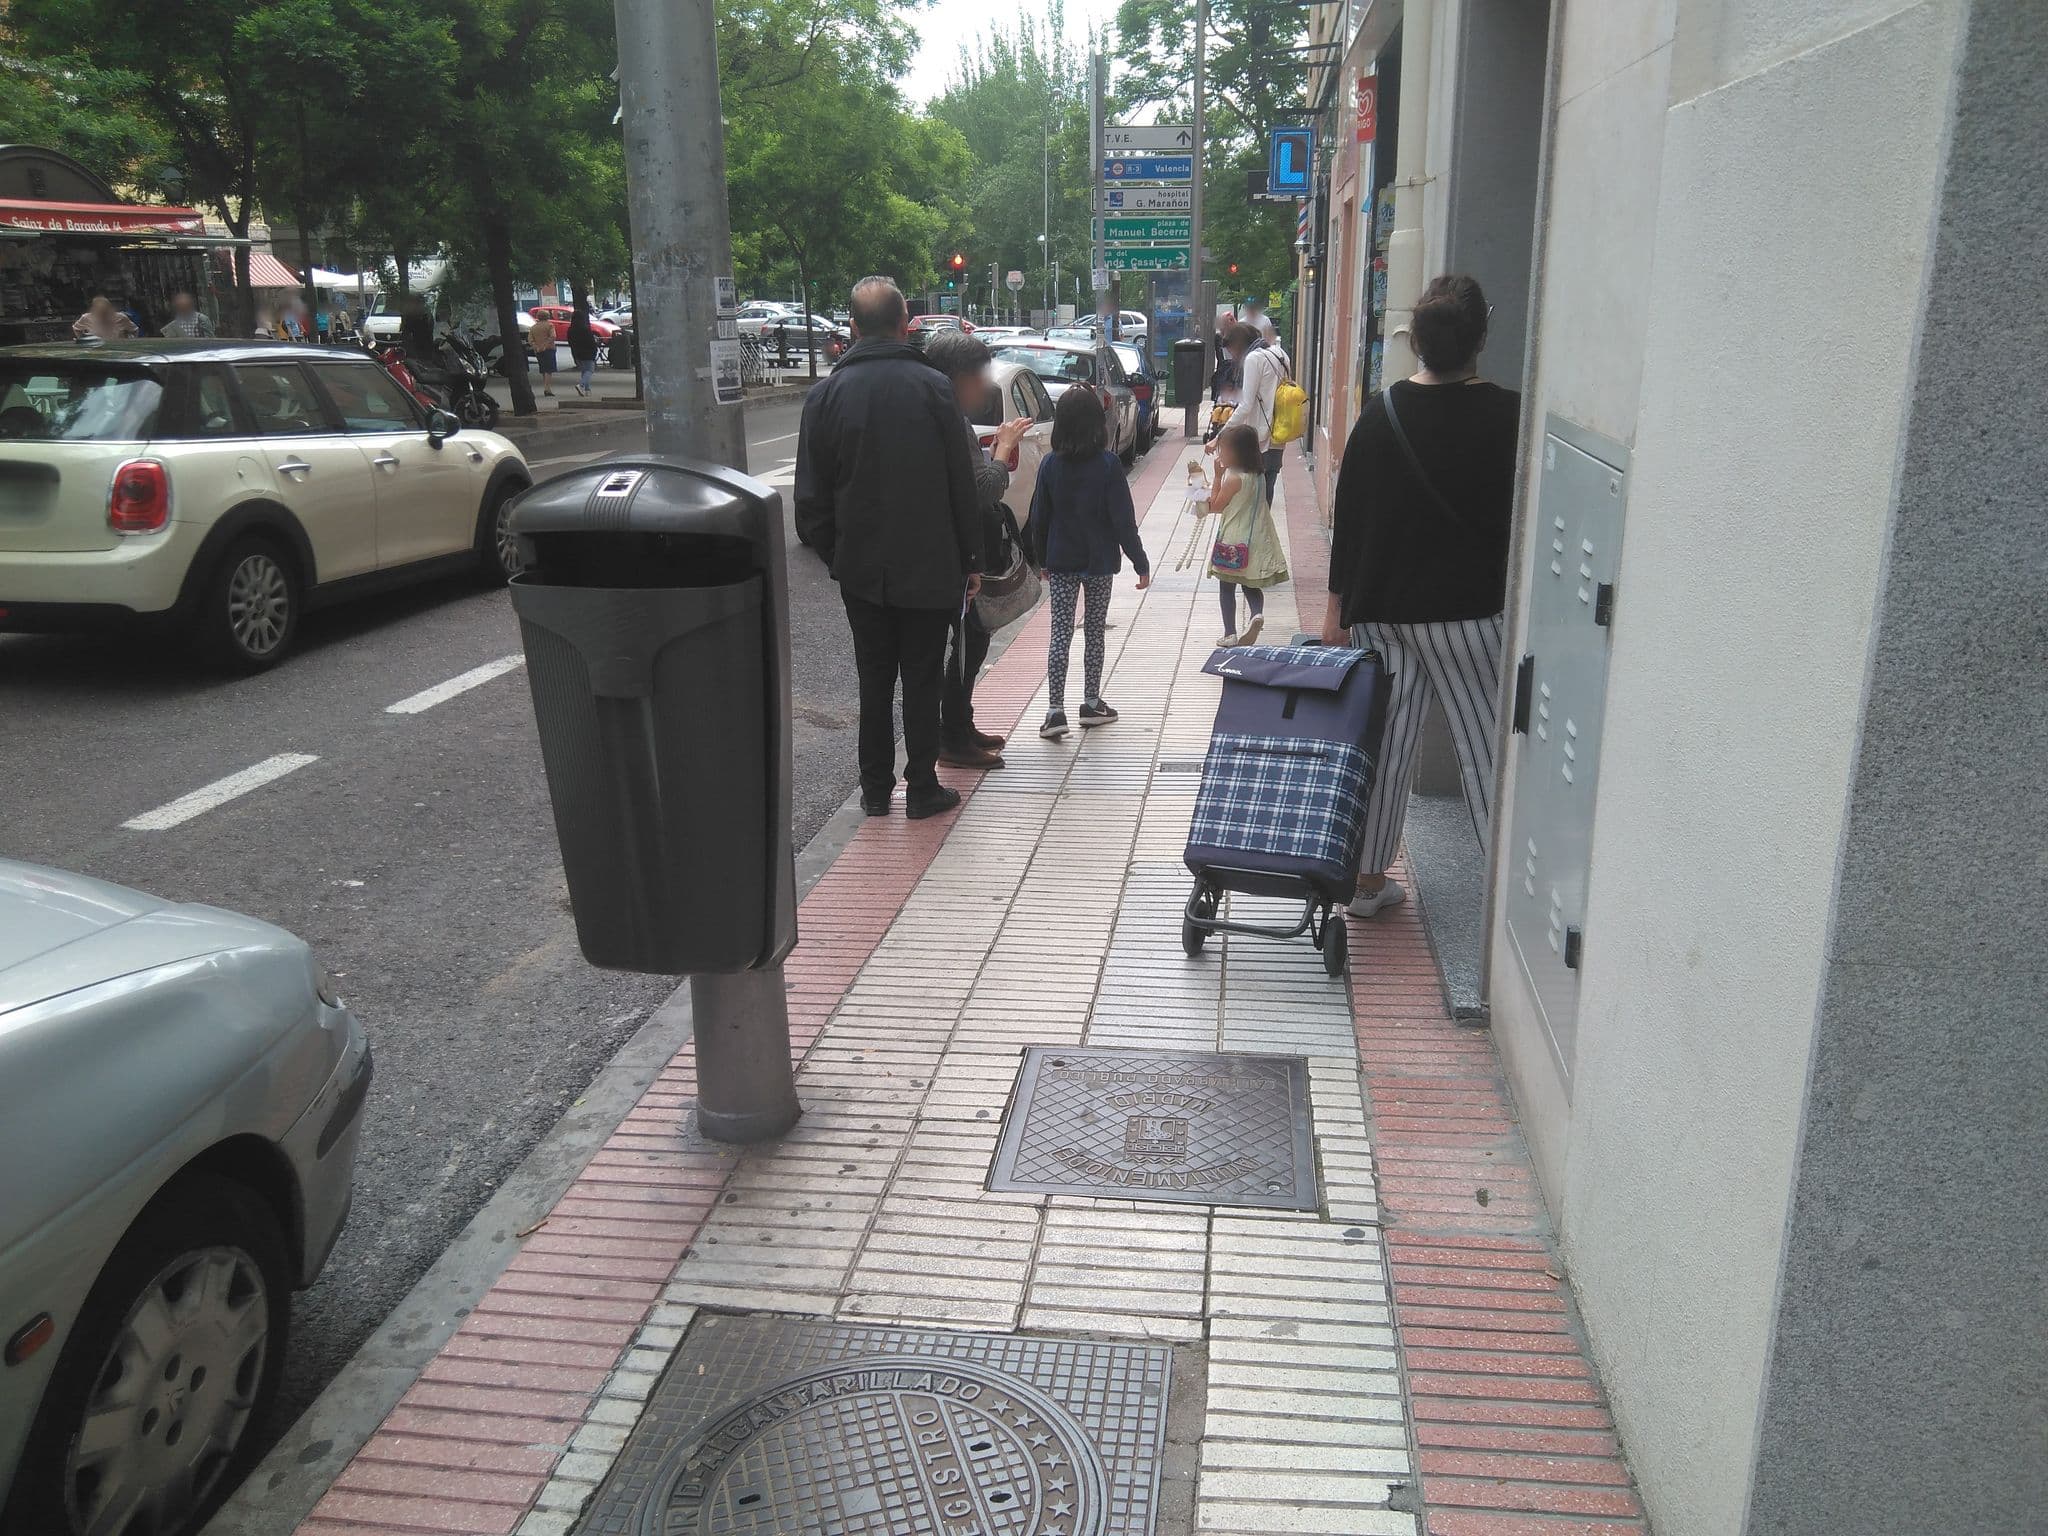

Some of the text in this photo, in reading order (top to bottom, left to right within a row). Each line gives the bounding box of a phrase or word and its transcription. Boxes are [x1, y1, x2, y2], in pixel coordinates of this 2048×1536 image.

[1357, 118, 1371, 128] RIGO
[1105, 134, 1133, 143] T.V.E.
[1155, 164, 1190, 173] Valencia
[1158, 189, 1189, 199] hospital
[1137, 200, 1146, 208] G.
[11, 216, 43, 229] Sainz
[48, 218, 63, 230] de
[66, 219, 110, 231] Baranda
[1109, 227, 1189, 237] Manuel Becerra
[1130, 258, 1158, 266] Casal
[1113, 1092, 1211, 1113] MADRID
[1054, 1147, 1262, 1187] AYUNTAMIENTO DE
[698, 1372, 982, 1471] ALCANTARILLADO
[912, 1409, 979, 1536] EGISTRO
